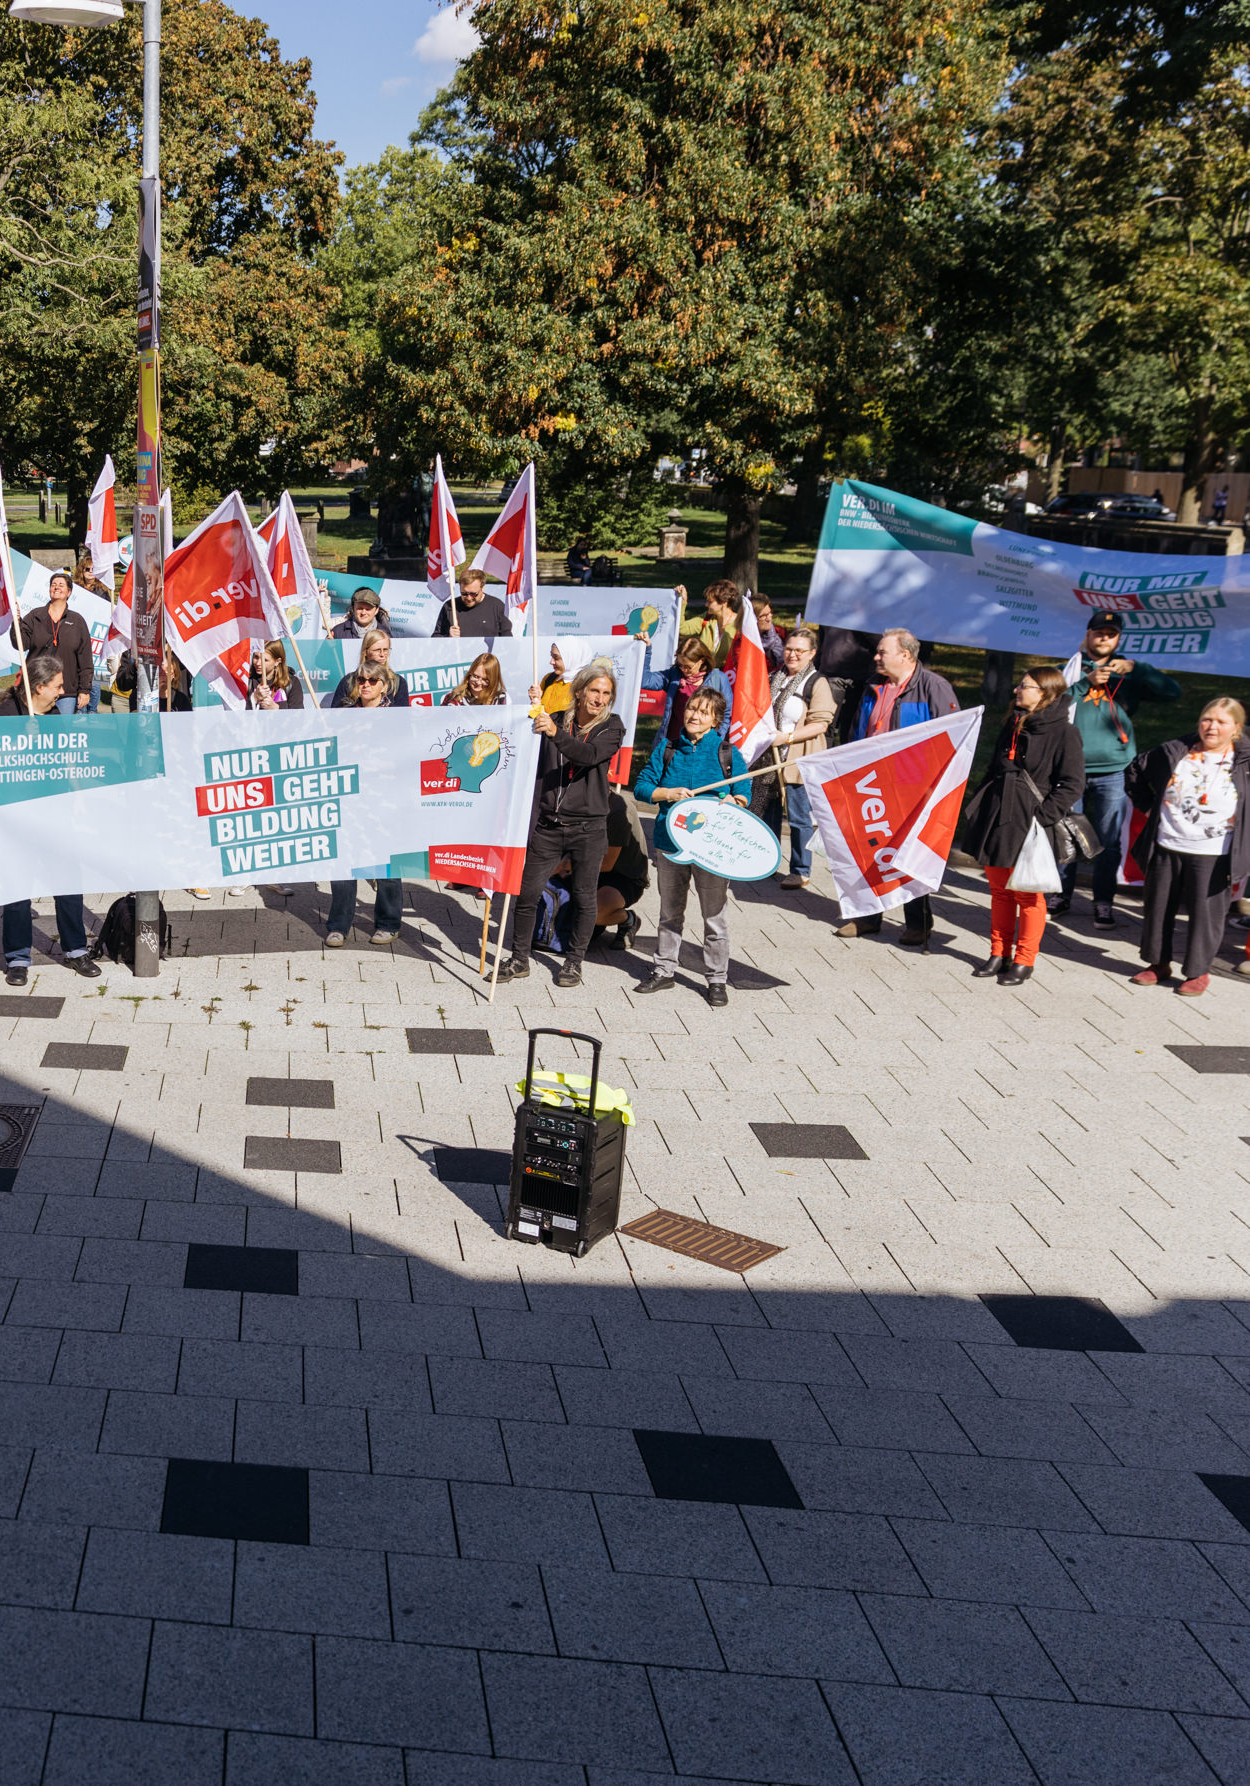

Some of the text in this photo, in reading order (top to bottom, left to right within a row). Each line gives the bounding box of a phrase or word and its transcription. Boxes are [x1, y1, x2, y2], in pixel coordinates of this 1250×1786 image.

[843, 494, 895, 515] VER.DI IM
[141, 514, 157, 530] SPD
[840, 509, 857, 518] BNW
[838, 518, 851, 527] DER
[996, 585, 1034, 597] SALZGITTER
[1084, 573, 1202, 592] NUR MIT
[999, 600, 1038, 611] WITTMUND
[1082, 590, 1220, 610] UNS GEHT
[1010, 615, 1040, 625] MEPPEN
[1123, 611, 1214, 629] LDUNG
[401, 671, 430, 692] UR
[37, 734, 54, 750] IN
[57, 733, 89, 749] DER
[211, 741, 331, 781] NUR MIT
[206, 769, 356, 813] UNS GEHT
[216, 803, 339, 843] BILDUNG
[226, 835, 331, 873] WEITER
[451, 853, 484, 864] Landesbezirk
[435, 858, 496, 873] NIEDERSACHSEN-BREMEN
